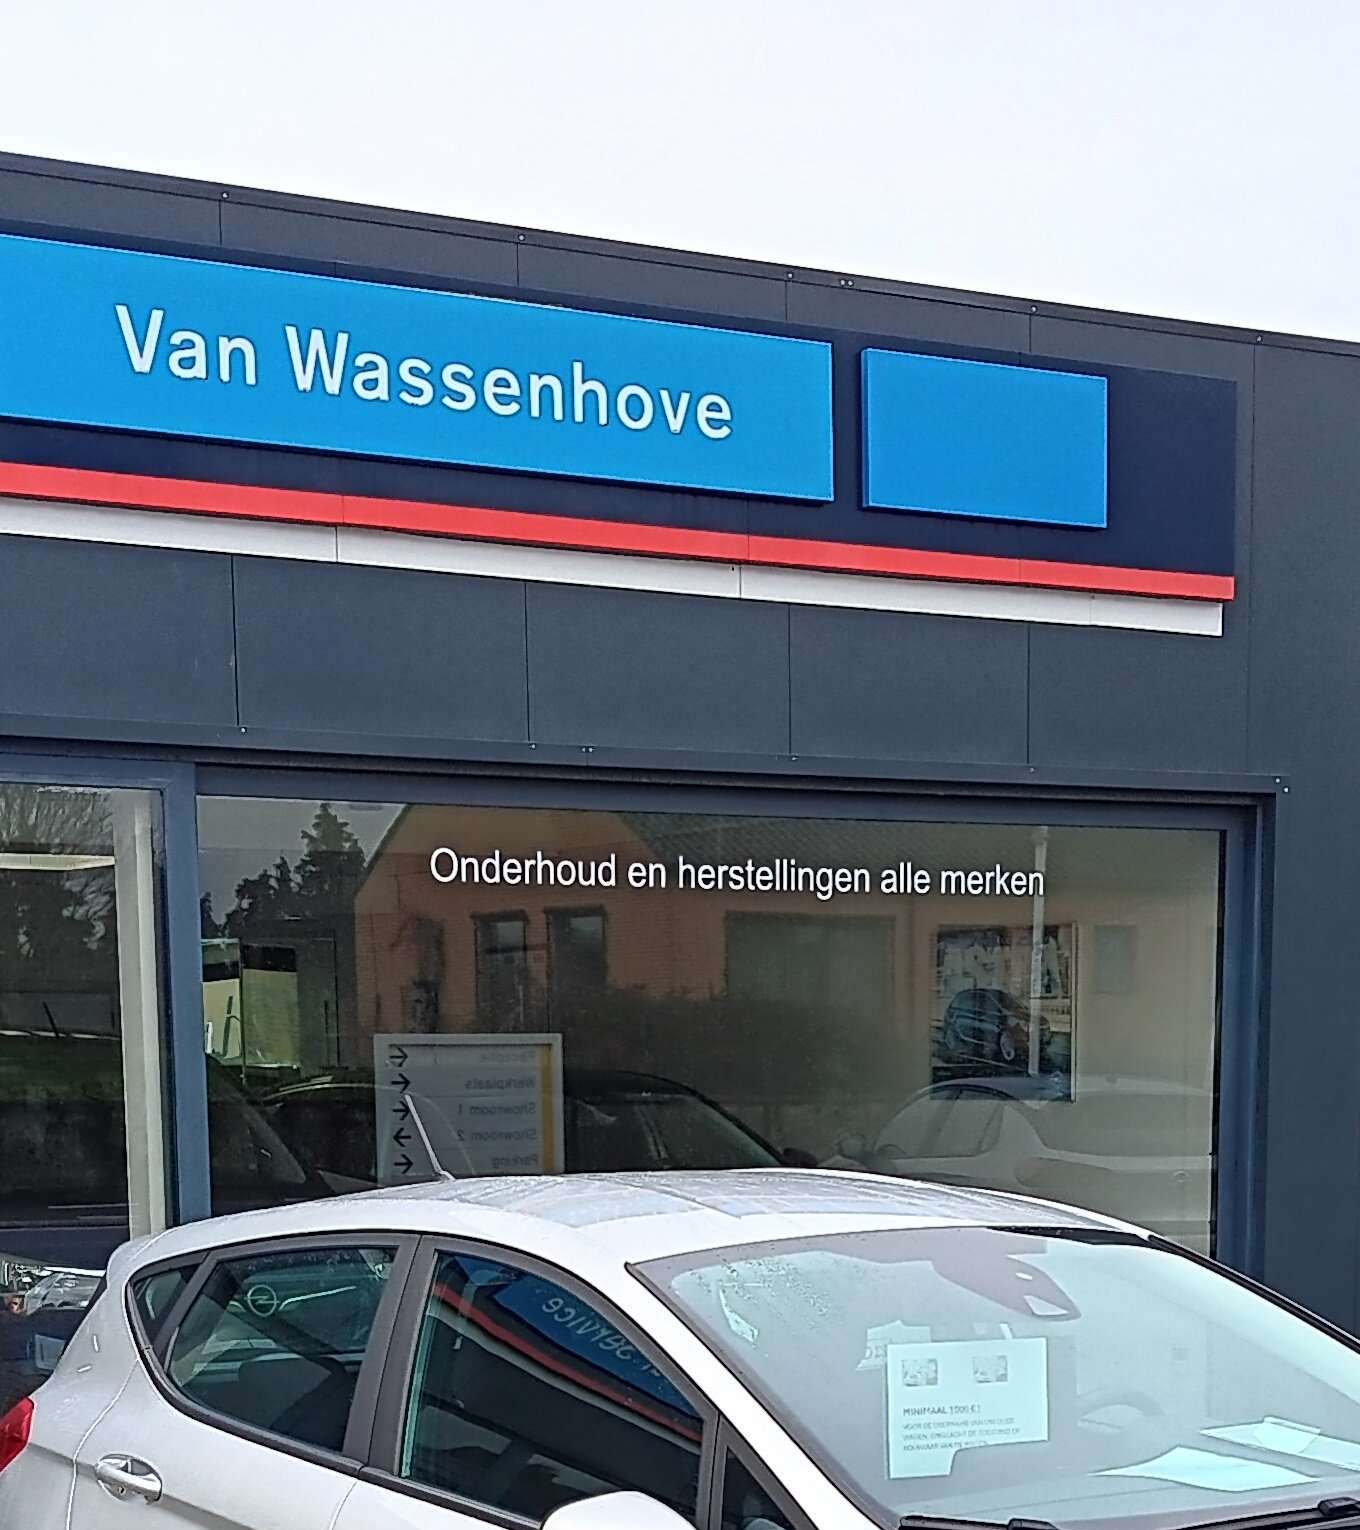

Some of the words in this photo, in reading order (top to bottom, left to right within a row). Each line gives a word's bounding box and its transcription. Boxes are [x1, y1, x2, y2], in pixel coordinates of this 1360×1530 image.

[116, 304, 256, 386] Van
[285, 325, 733, 440] Wassenhove
[429, 847, 617, 888] Onderhoud
[627, 861, 667, 889] en
[678, 855, 871, 901] herstellingen
[880, 861, 931, 894] alle
[940, 863, 1045, 896] merken
